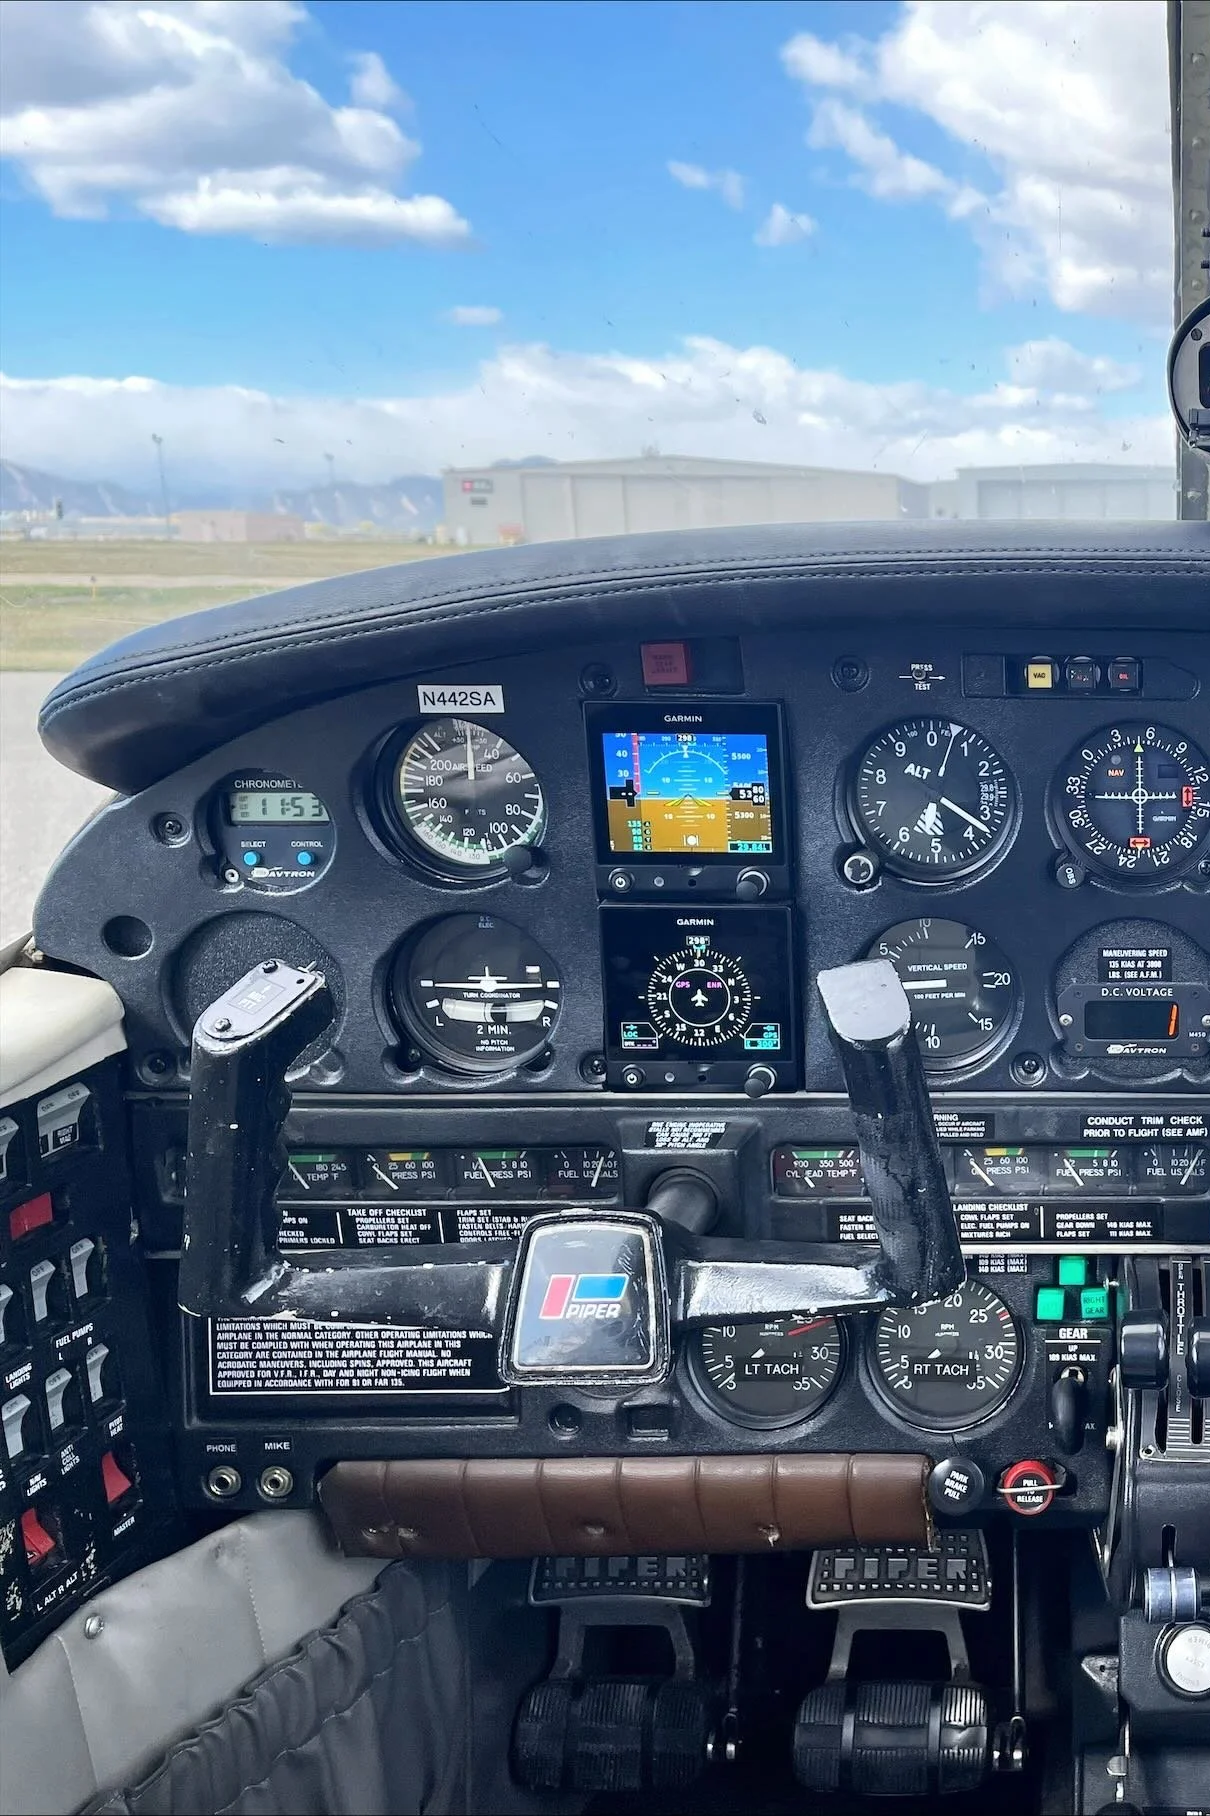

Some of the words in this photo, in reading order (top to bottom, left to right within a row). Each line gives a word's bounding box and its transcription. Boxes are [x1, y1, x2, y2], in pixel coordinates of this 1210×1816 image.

[423, 692, 495, 706] N442SA
[430, 760, 451, 771] 200
[904, 763, 931, 780] ALT
[426, 776, 442, 786] 180
[506, 772, 521, 783] 60
[428, 798, 446, 809] 160
[505, 805, 520, 815] 80
[489, 823, 508, 834] 100
[908, 964, 941, 972] VERTICAL
[994, 973, 1010, 985] 20
[1126, 988, 1173, 996] VOLTAGE
[477, 1026, 484, 1034] 2
[488, 1026, 511, 1035] MIN.
[1087, 1117, 1134, 1125] CONDUCT
[1141, 1117, 1163, 1125] TRIM
[1170, 1116, 1202, 1125] CHECK
[1186, 1128, 1207, 1136] AMF)
[566, 1303, 619, 1318] PIPER
[56, 1333, 71, 1348] FUEL
[71, 1323, 94, 1341] PUMPS
[1059, 1328, 1087, 1339] GEAR
[745, 1364, 760, 1375] LT
[765, 1364, 799, 1375] TACH
[914, 1364, 932, 1375] RT
[936, 1364, 969, 1376] TACH
[218, 1378, 251, 1387] EQUIPPED
[254, 1378, 261, 1387] IN
[265, 1378, 312, 1387] ACCORDANCE
[314, 1378, 333, 1387] WITH
[206, 1444, 236, 1452] PHONE
[264, 1441, 290, 1450] MIKE
[951, 1470, 969, 1483] PARK
[945, 1479, 967, 1493] BRAKE
[944, 1488, 961, 1499] PULL
[1017, 1494, 1043, 1503] RELEASE
[114, 1517, 135, 1536] MASTER
